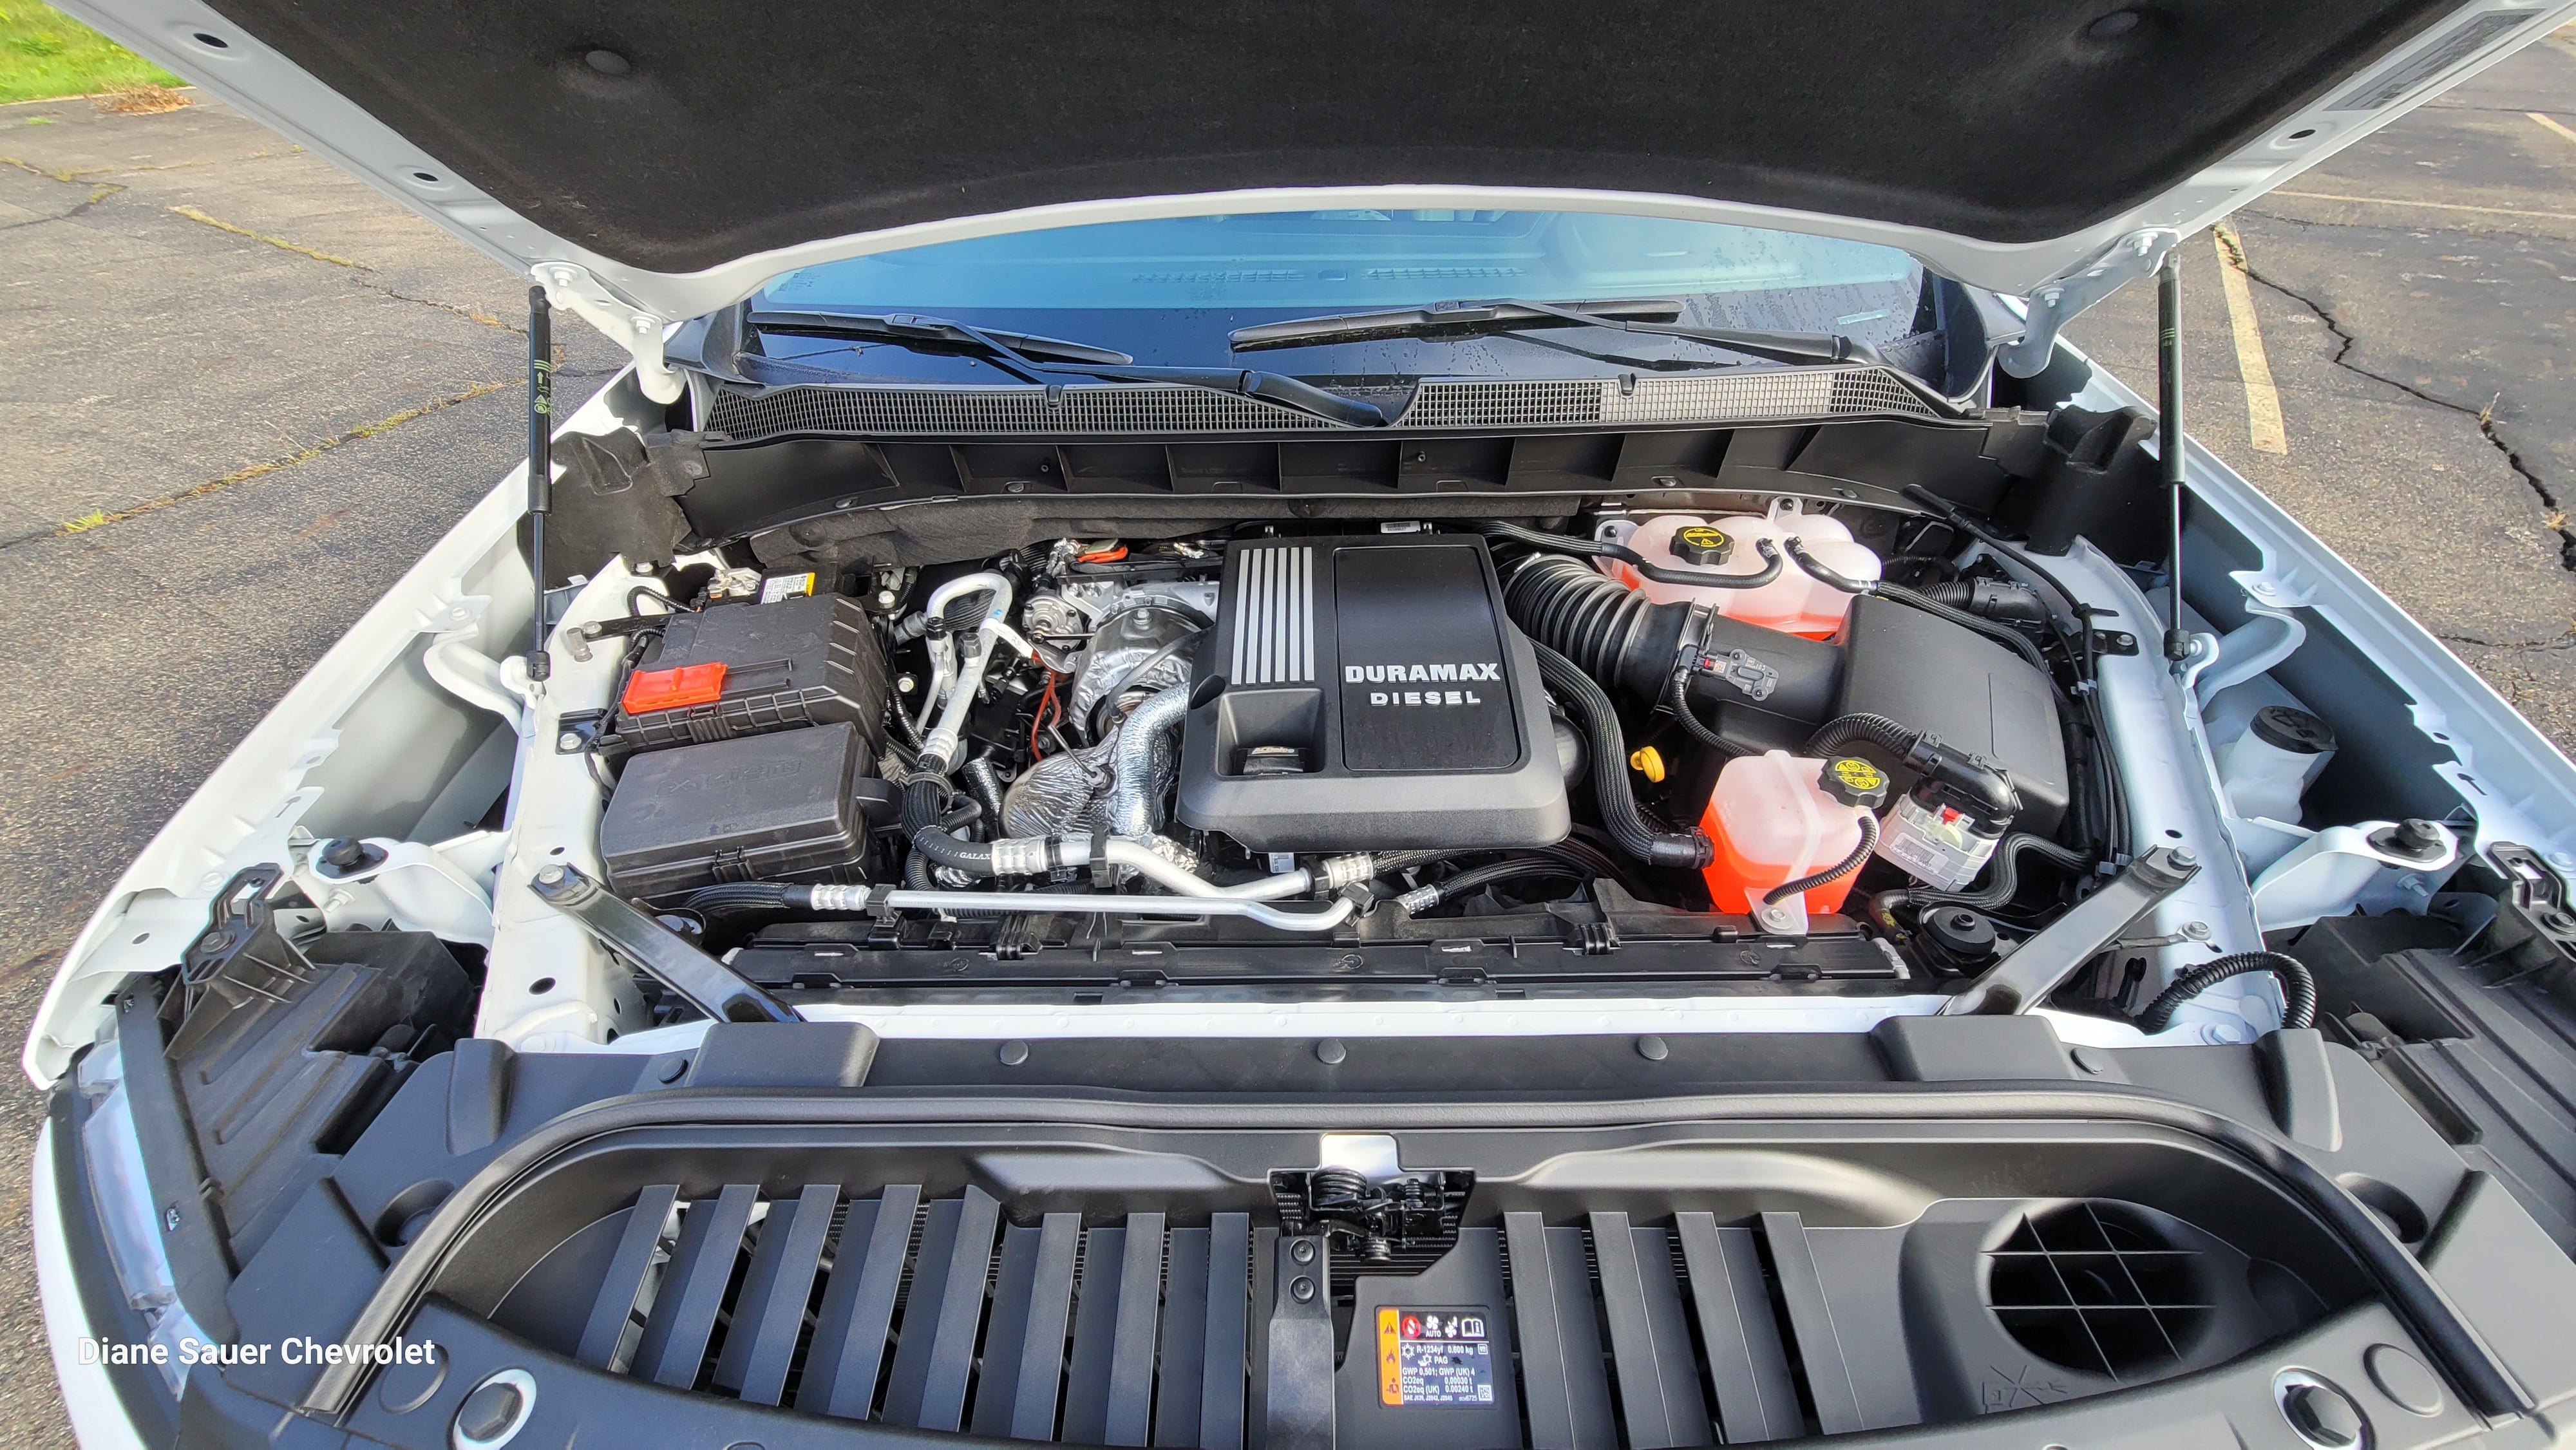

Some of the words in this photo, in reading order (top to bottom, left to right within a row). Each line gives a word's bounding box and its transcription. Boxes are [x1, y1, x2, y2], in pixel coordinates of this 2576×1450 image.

[1345, 663, 1501, 683] DURAMAX
[1370, 691, 1481, 706] DIESEL
[1466, 1346, 1473, 1355] kg
[1456, 1368, 1470, 1377] (UK)
[1403, 1377, 1424, 1386] CO2eq
[1404, 1386, 1424, 1395] CO2eq
[1425, 1386, 1439, 1395] (UK)
